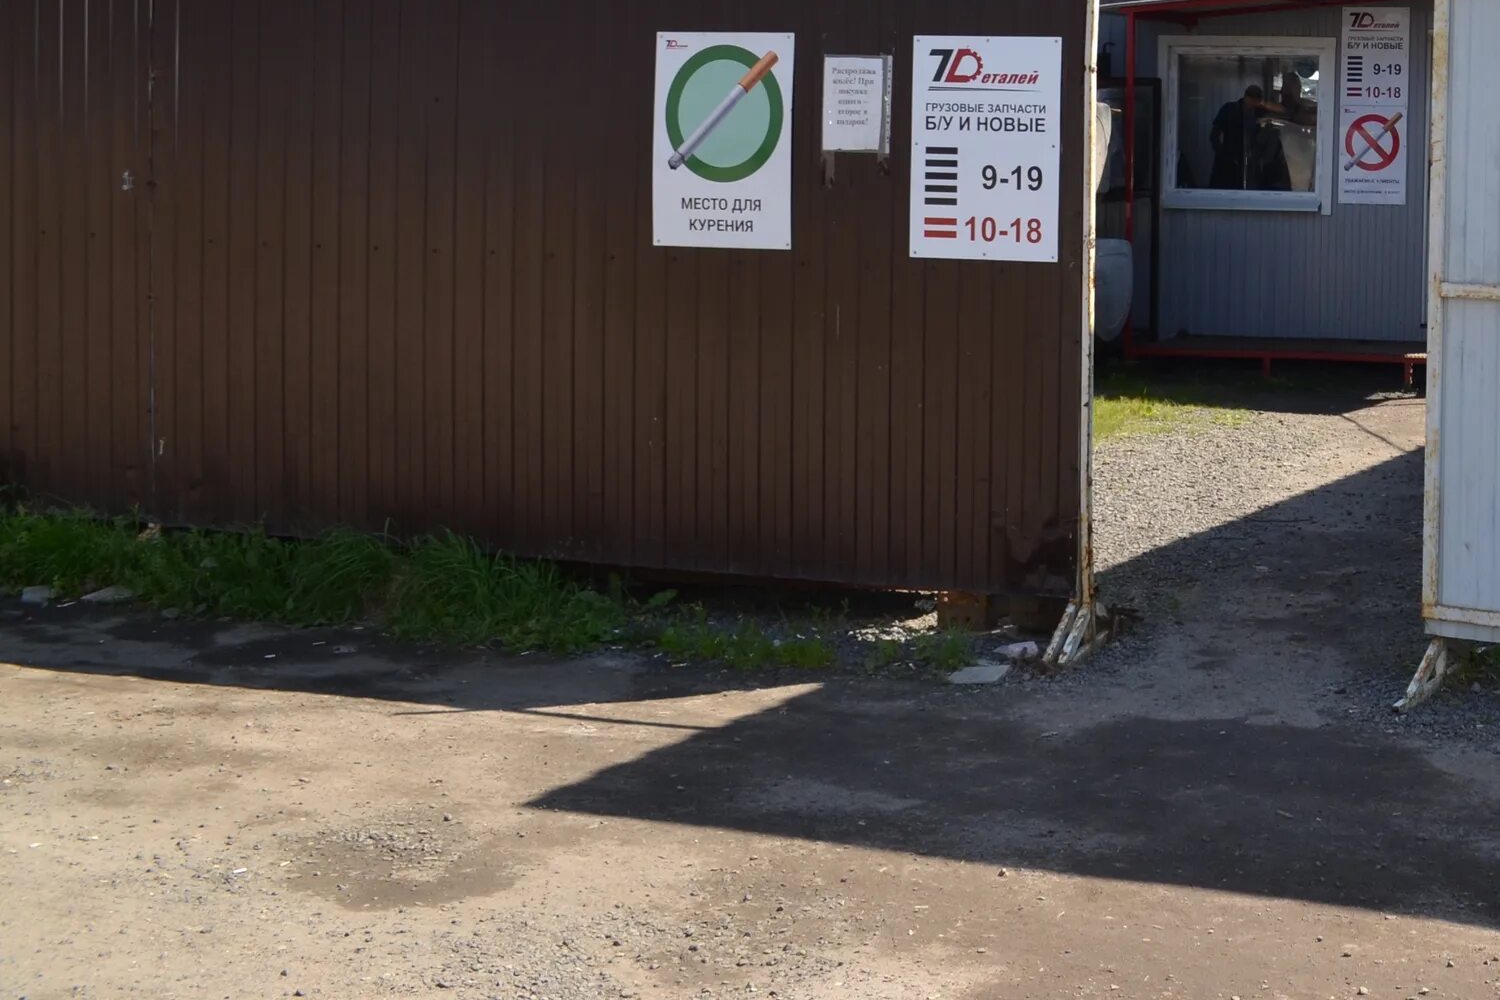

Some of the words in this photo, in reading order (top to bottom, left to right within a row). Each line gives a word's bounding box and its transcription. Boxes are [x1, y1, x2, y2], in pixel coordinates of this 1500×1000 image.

[1363, 42, 1369, 50] И
[1371, 42, 1404, 50] НОВЫЕ
[1373, 63, 1402, 75] 9-19
[1365, 86, 1401, 98] 10-18
[925, 103, 984, 113] ГРУЗОВЫЕ
[988, 104, 1046, 114] ЗАПЧАСТИ
[925, 116, 953, 131] Б/У
[960, 116, 970, 131] И
[977, 117, 1046, 132] НОВЫЕ
[982, 165, 1043, 191] 9-19
[681, 198, 728, 210] МЕСТО
[732, 199, 761, 213] ДЛЯ
[689, 219, 753, 232] КУРЕНИЯ
[965, 216, 1042, 243] 10-18
